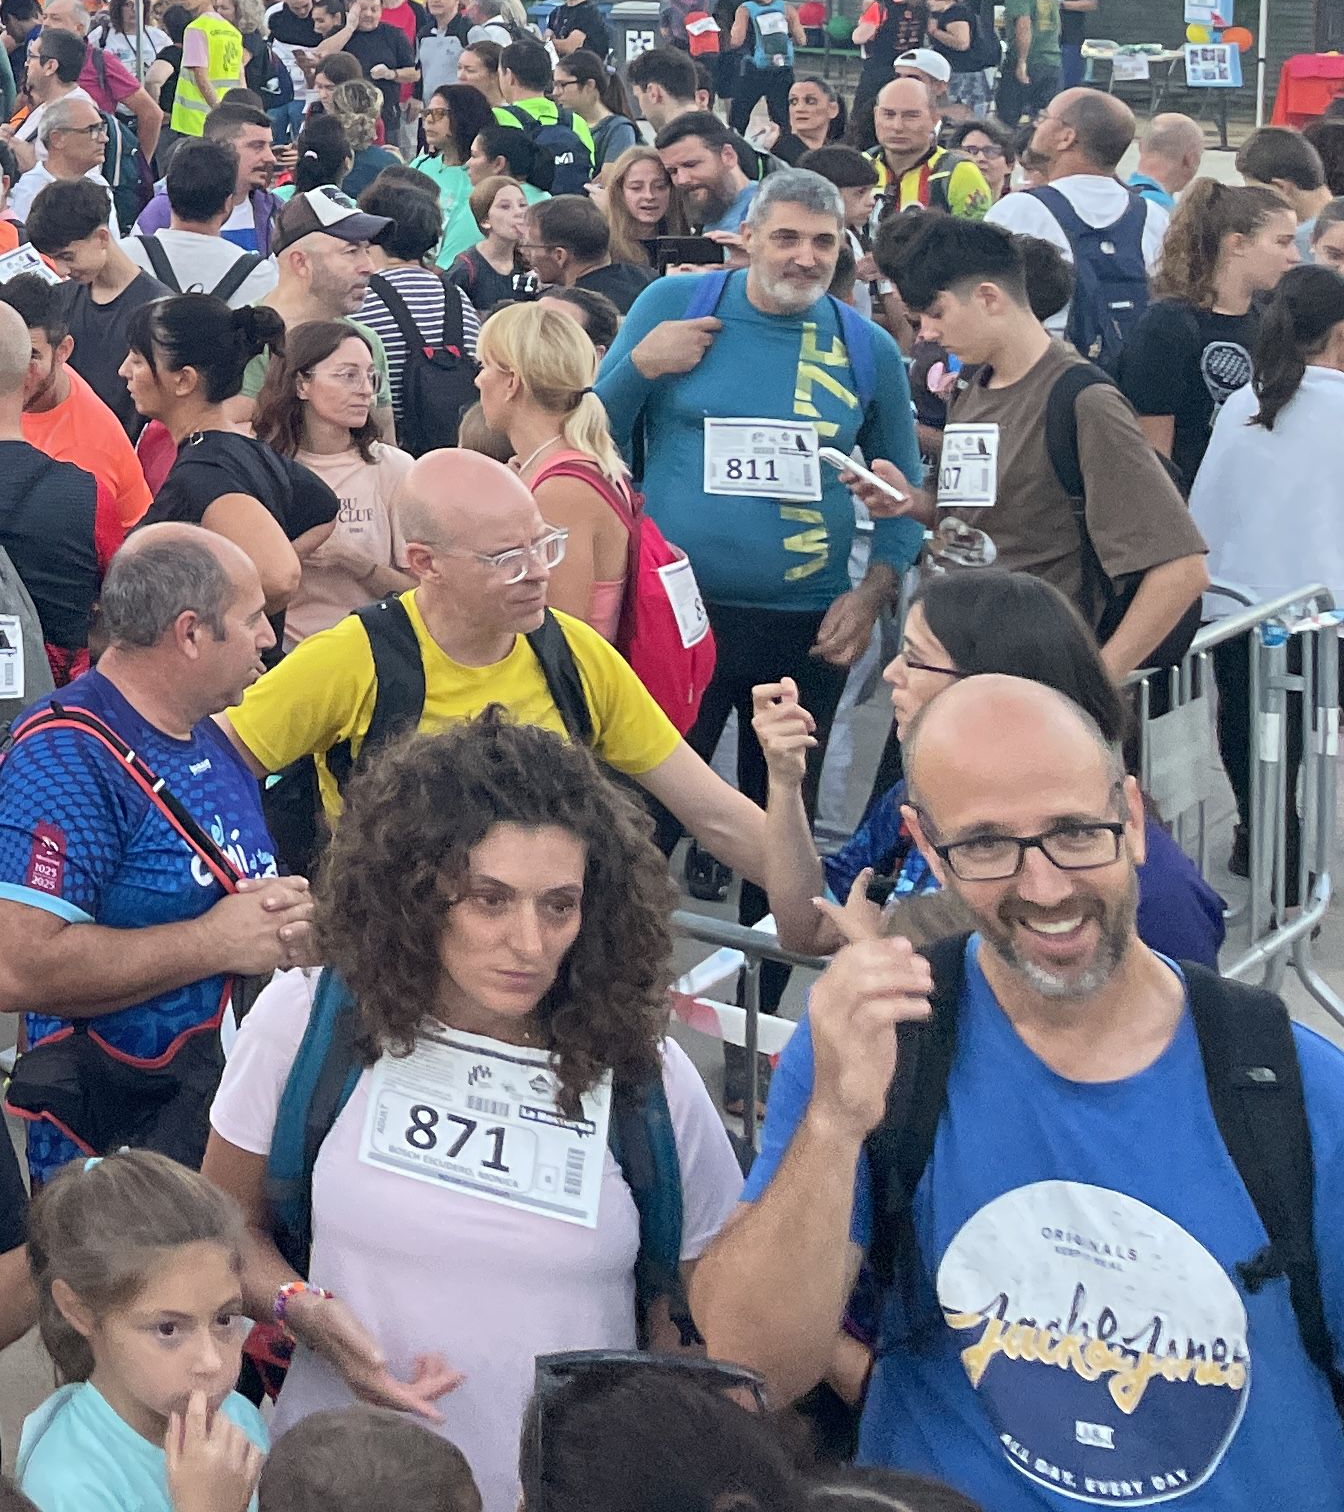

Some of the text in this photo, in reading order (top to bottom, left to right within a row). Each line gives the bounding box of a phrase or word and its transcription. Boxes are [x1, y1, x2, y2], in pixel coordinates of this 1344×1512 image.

[727, 458, 780, 481] 811
[405, 1104, 510, 1172] 871
[1150, 1468, 1191, 1492] DAY
